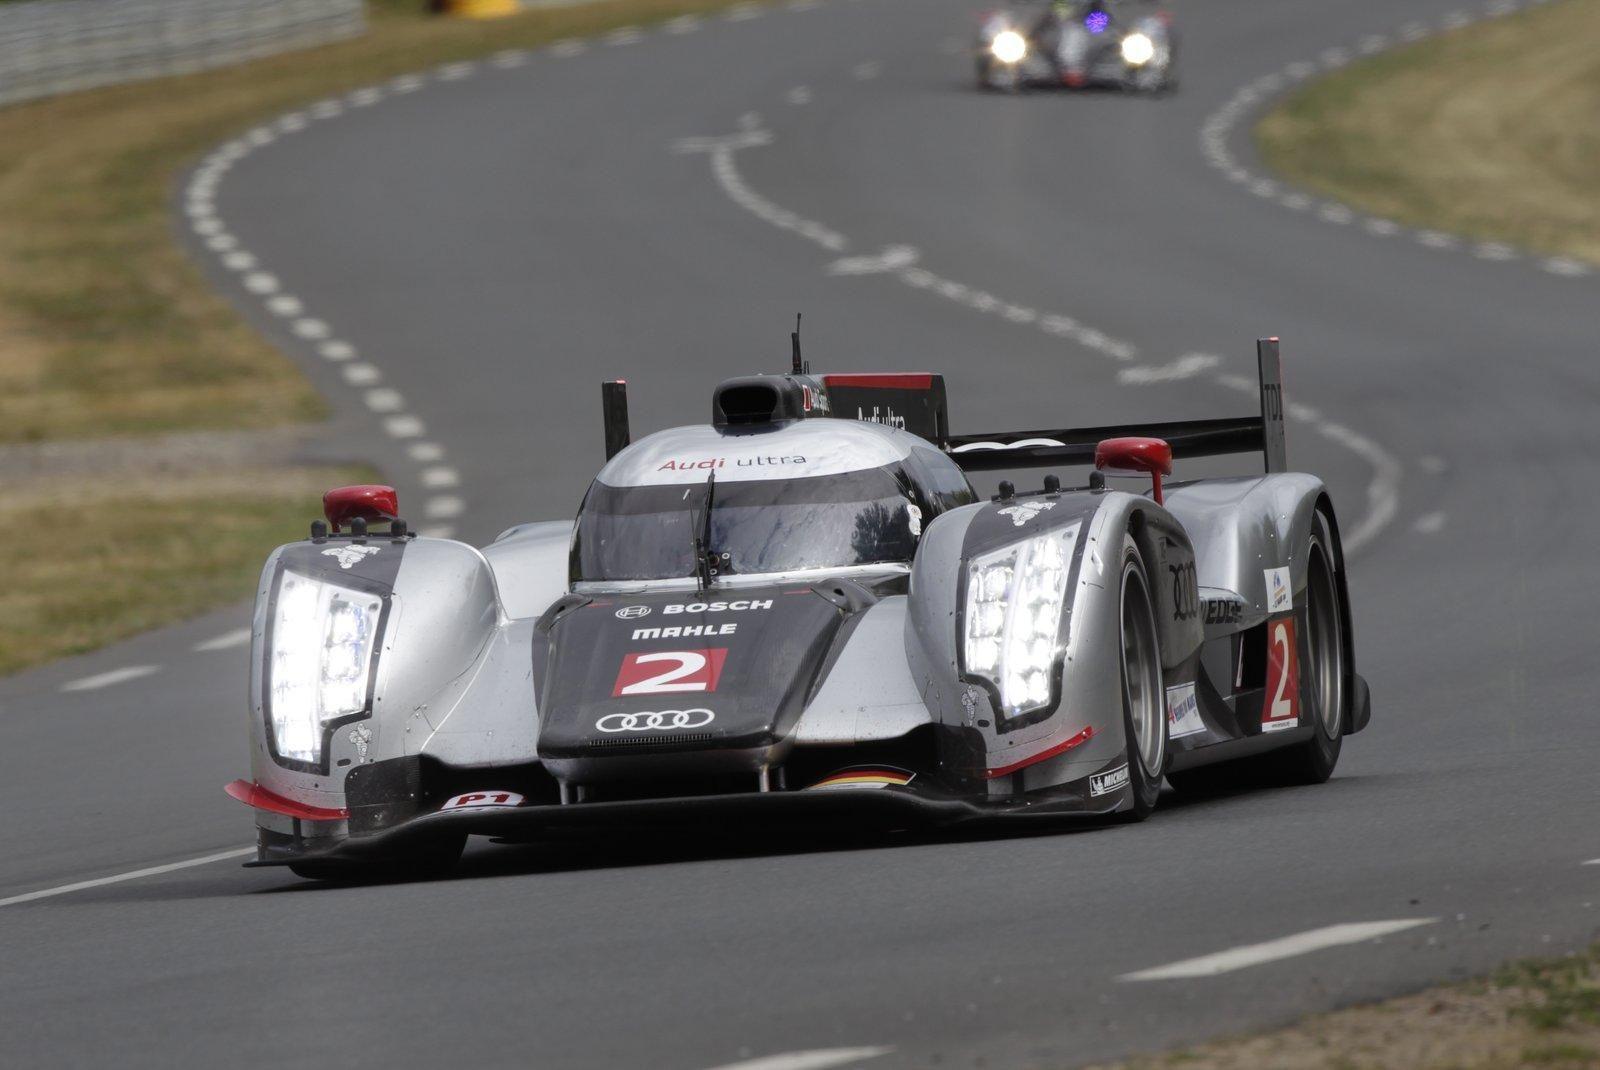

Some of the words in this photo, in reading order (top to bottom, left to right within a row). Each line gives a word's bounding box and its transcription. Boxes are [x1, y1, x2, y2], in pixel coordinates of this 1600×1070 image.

[858, 406, 880, 422] Adi
[657, 458, 725, 471] Audi
[737, 455, 807, 467] ultra
[663, 600, 773, 614] BOSCH
[632, 623, 737, 640] MAHLE
[621, 651, 707, 695] 2
[1270, 623, 1291, 718] 2
[456, 793, 510, 806] P1
